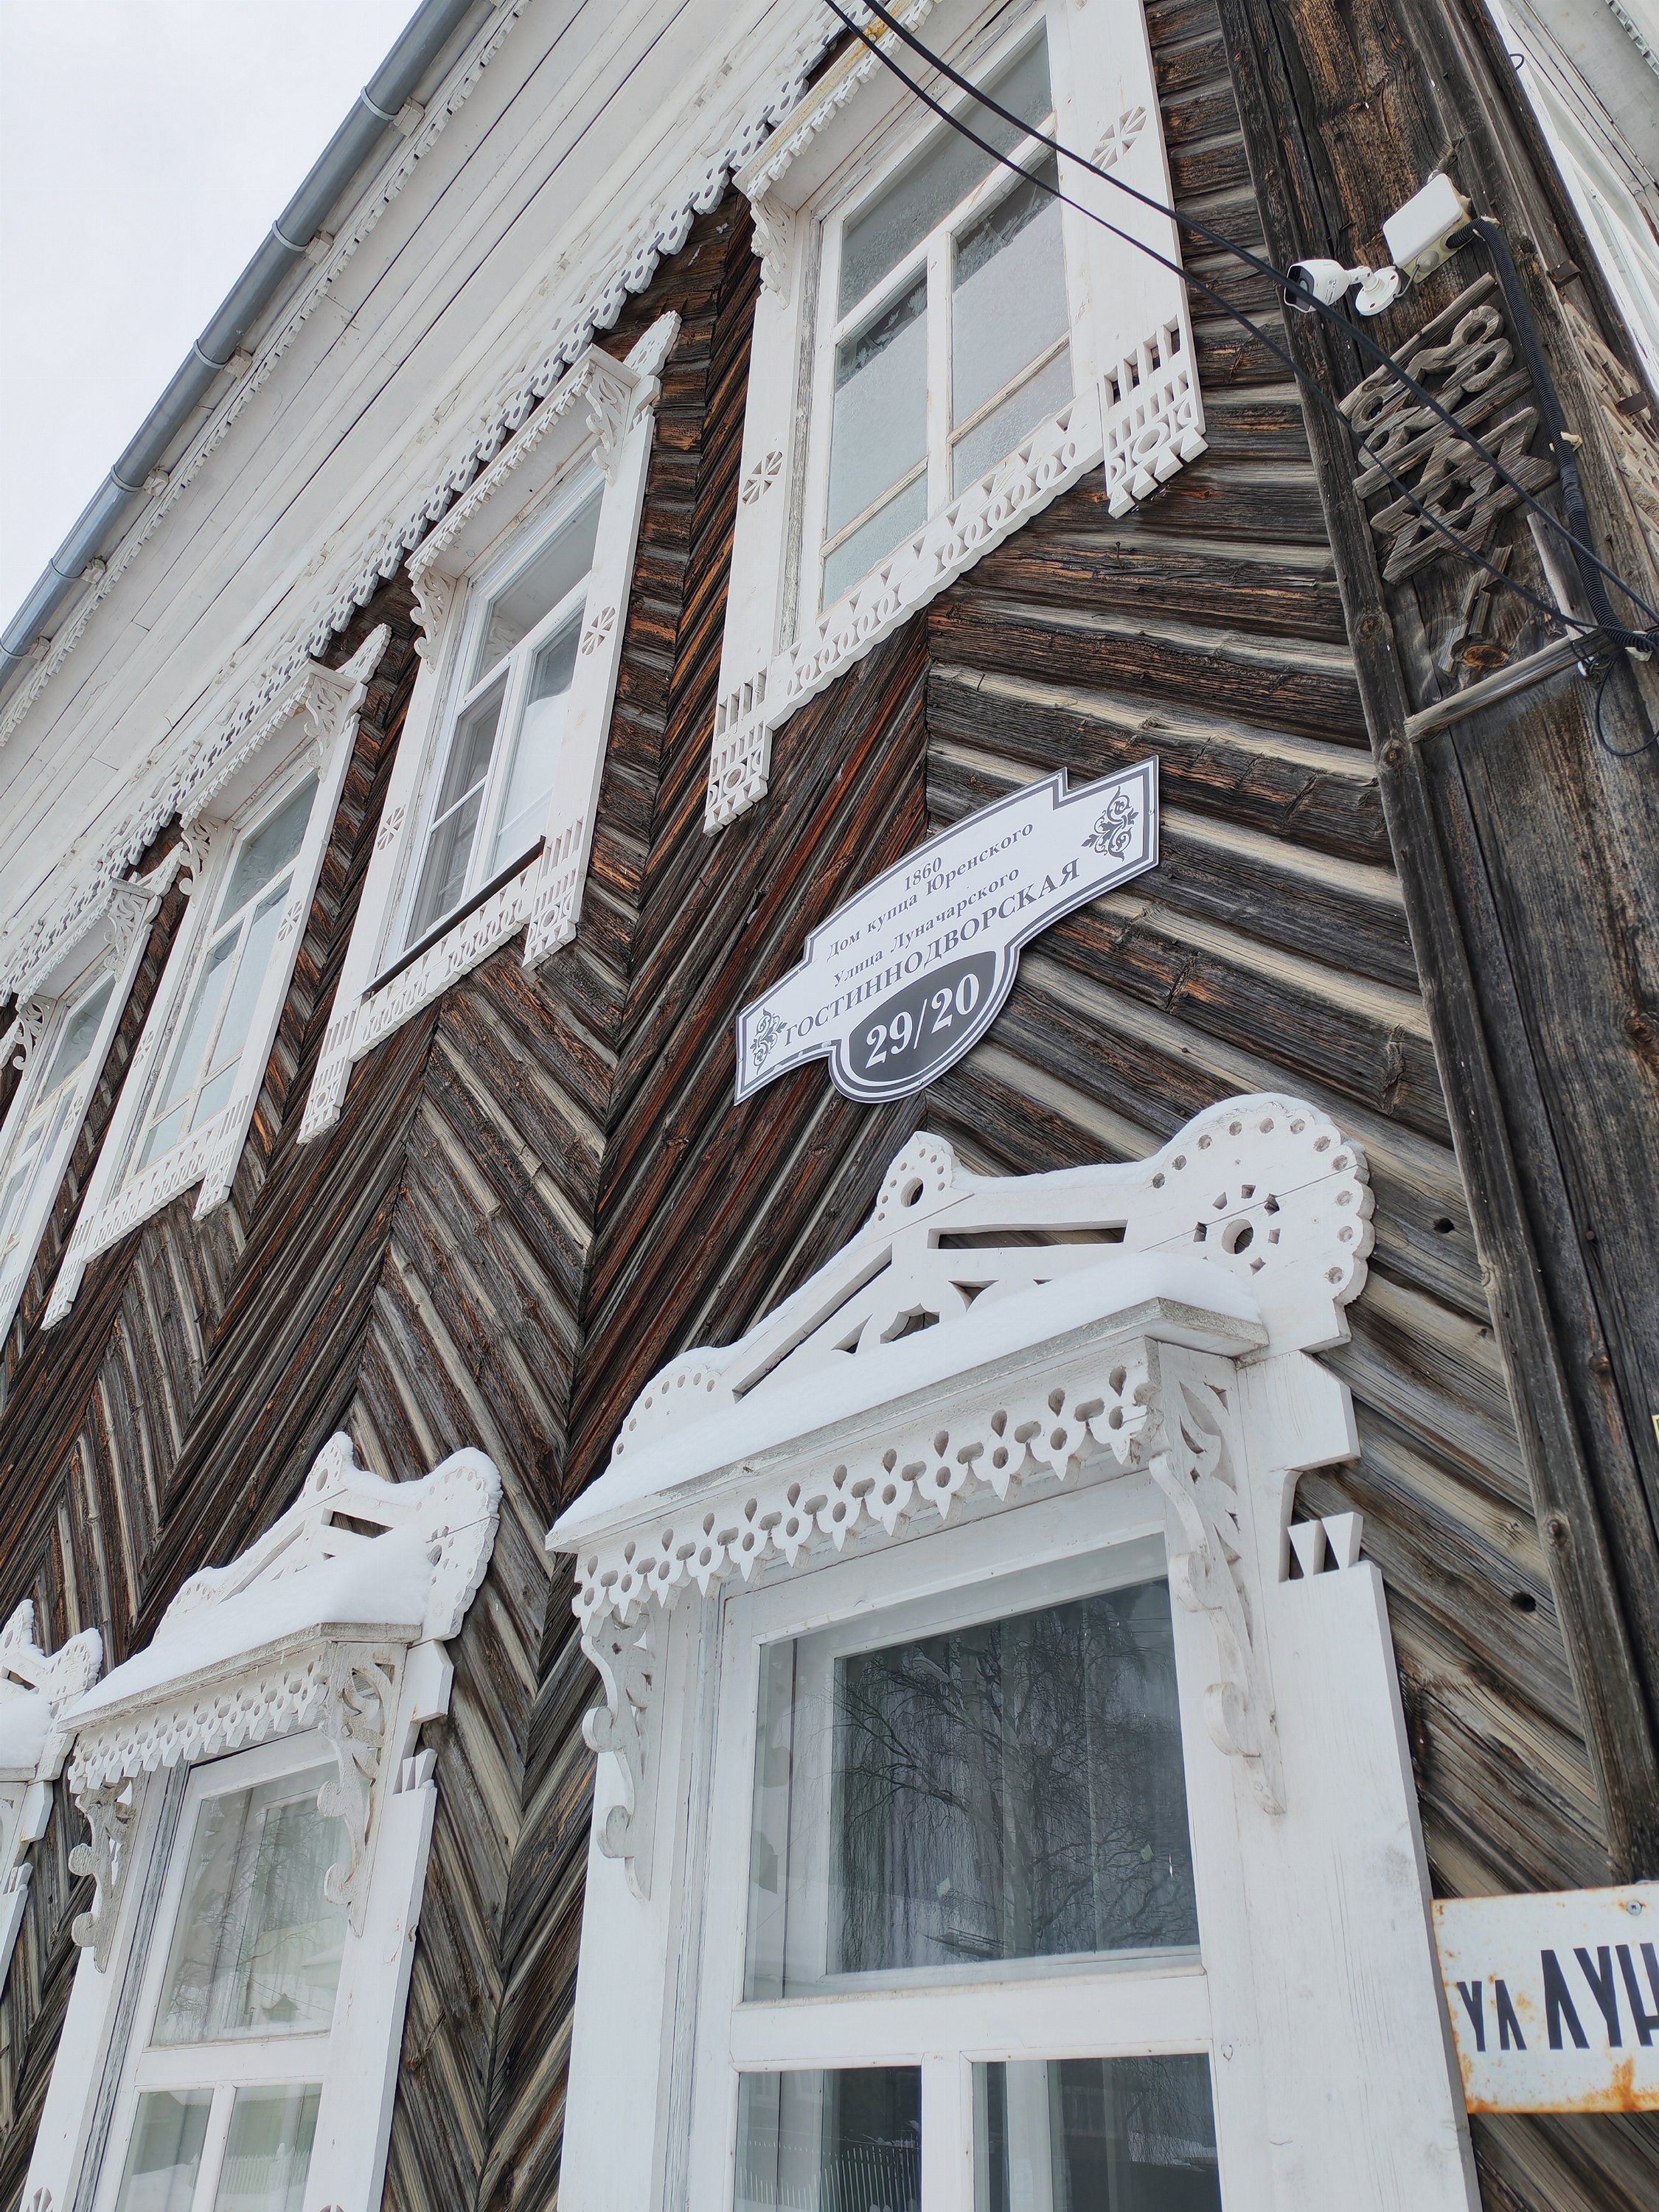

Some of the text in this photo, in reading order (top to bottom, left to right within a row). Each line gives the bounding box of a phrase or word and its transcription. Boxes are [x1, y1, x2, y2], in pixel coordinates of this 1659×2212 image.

[827, 824, 1033, 962] Дом купца Юренского
[904, 856, 942, 891] 1860
[784, 858, 1080, 1047] ГОСТИННОДВОРСКАЯ
[833, 869, 1019, 987] Улица Луначарского
[865, 973, 980, 1069] 29/20
[1456, 1980, 1527, 2052] УЛ
